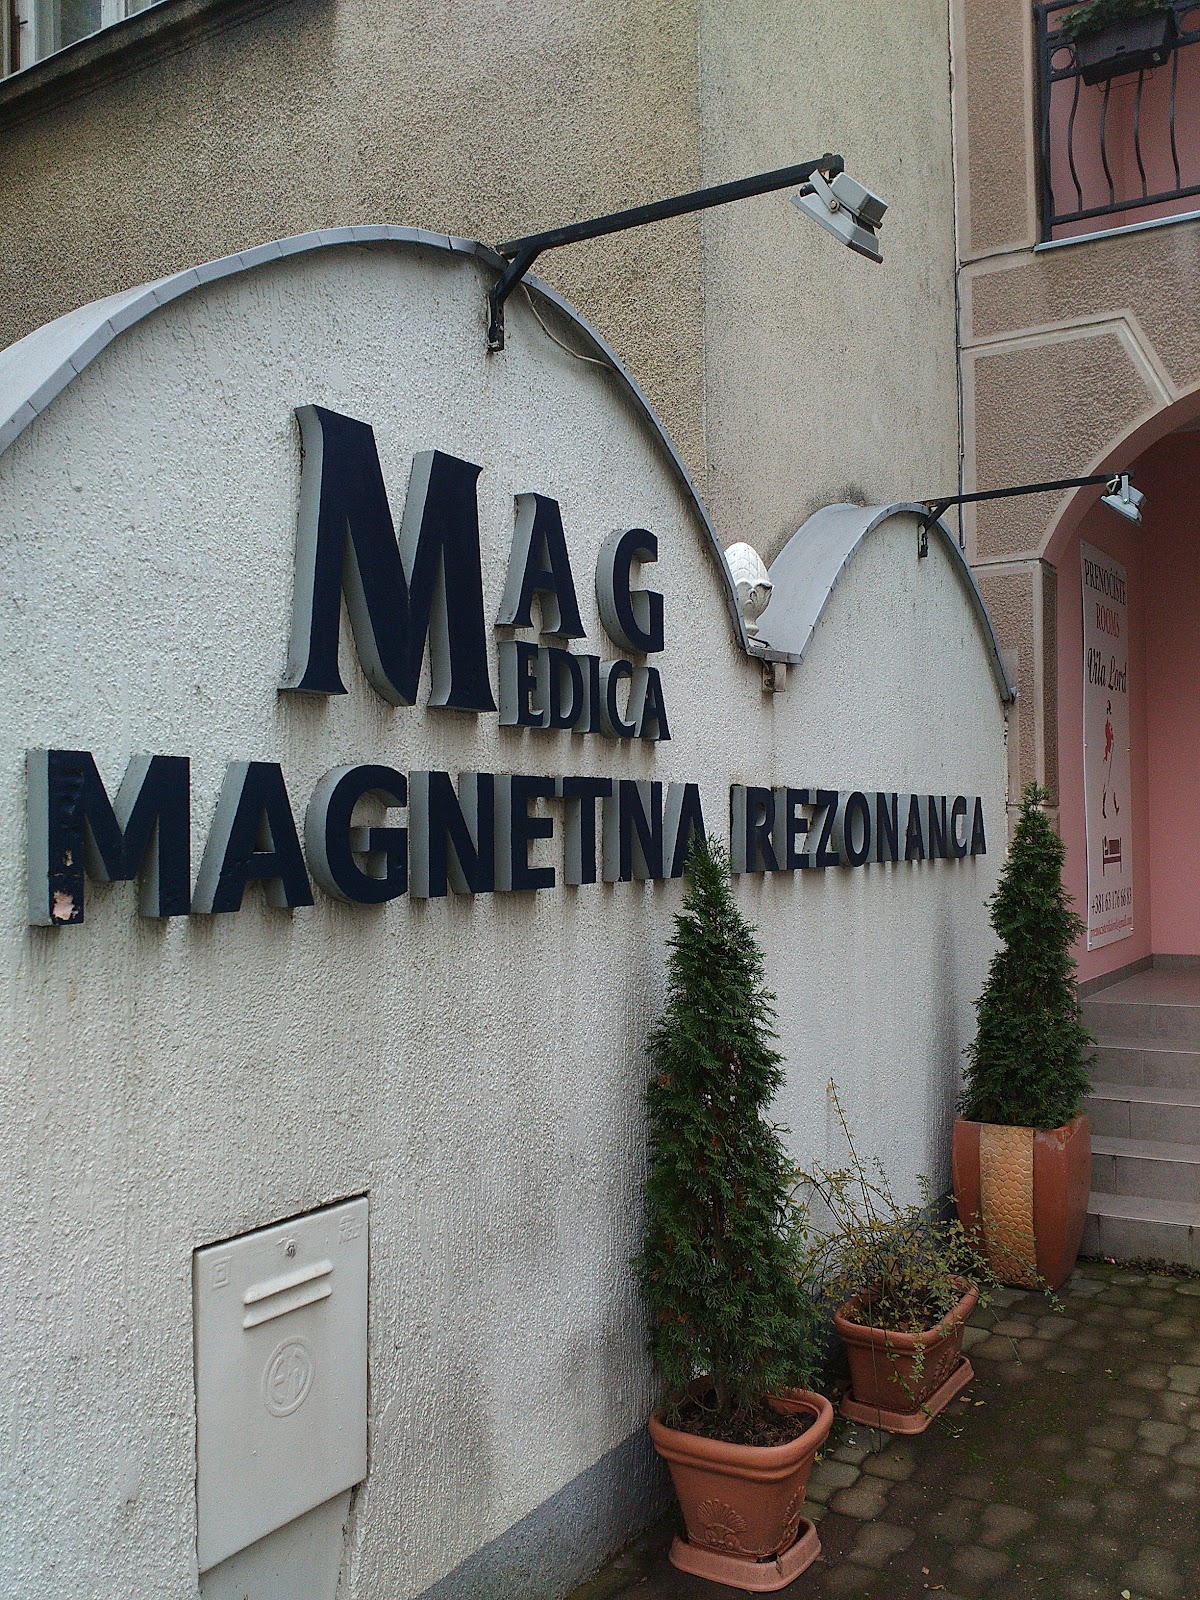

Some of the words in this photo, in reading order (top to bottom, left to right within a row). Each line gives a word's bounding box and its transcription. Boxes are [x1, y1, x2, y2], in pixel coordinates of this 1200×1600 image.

[1095, 602, 1120, 639] ROOMS
[1087, 647, 1106, 687] Vila
[1107, 655, 1128, 694] Lord
[27, 749, 707, 927] MAGNETNA
[730, 784, 987, 874] REZONANCA
